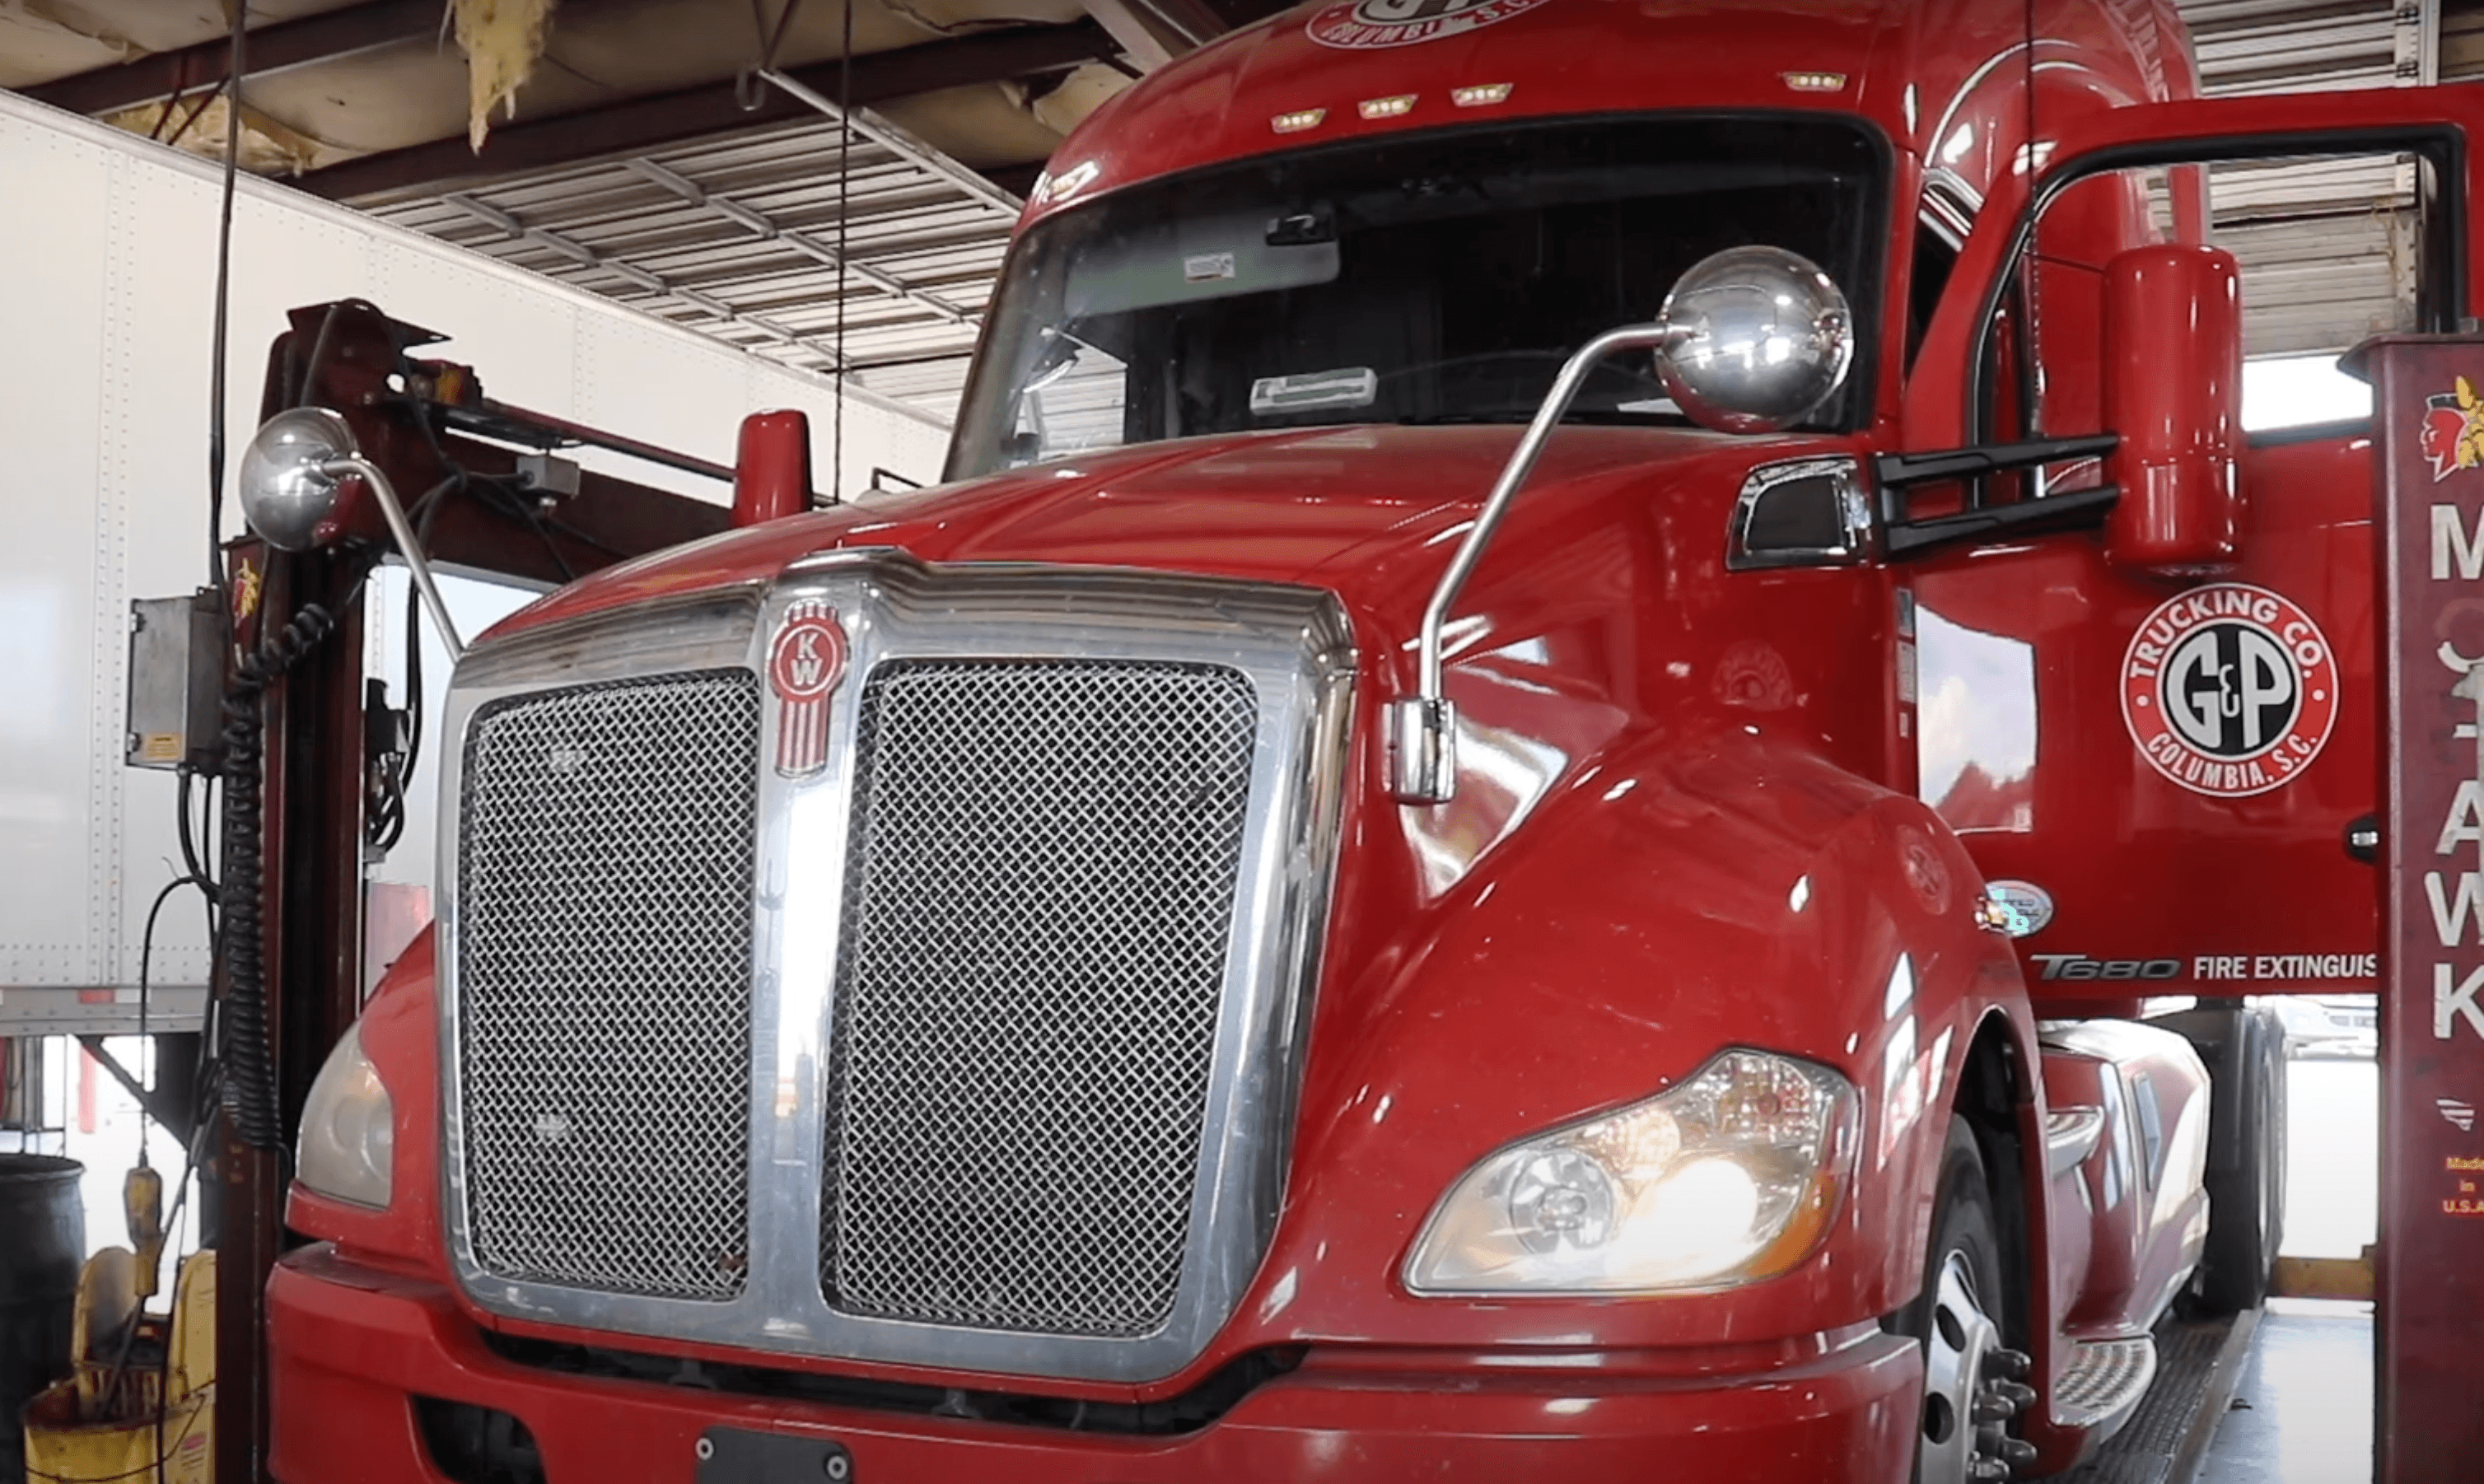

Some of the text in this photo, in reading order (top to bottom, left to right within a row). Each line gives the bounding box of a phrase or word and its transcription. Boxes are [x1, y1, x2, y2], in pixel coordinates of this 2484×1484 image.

[2130, 590, 2323, 679] TRUCKING CO.
[2166, 629, 2292, 749] G&P
[2272, 734, 2318, 772] S.C.
[2029, 954, 2181, 981] T680
[2193, 953, 2377, 979] FIRE EXTINGUIS
